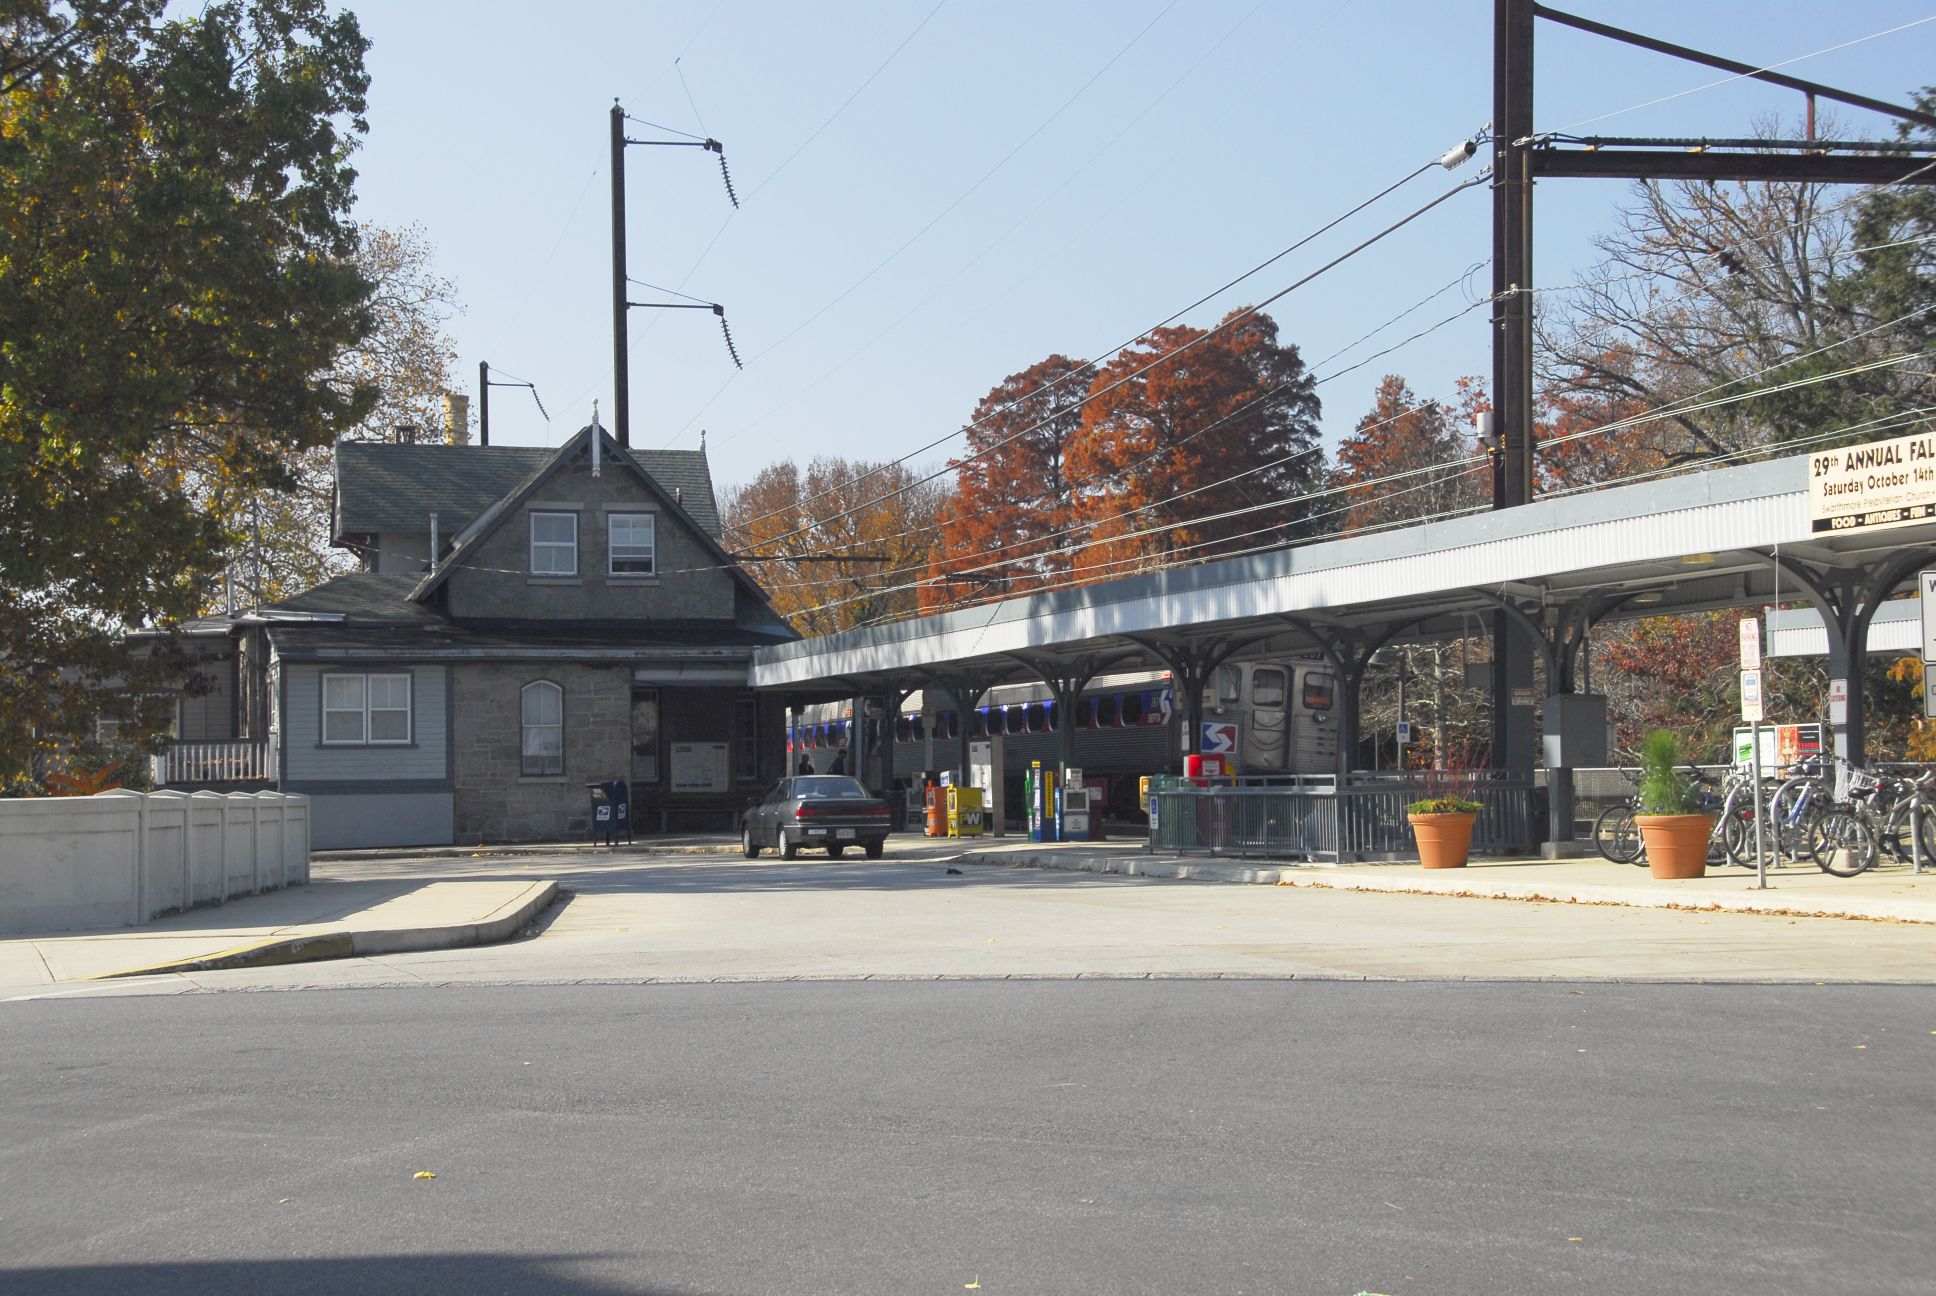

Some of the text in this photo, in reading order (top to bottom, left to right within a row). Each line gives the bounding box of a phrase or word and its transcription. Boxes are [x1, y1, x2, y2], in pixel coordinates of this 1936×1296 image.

[1814, 438, 1936, 477] 29th ANNUAL FAL
[1823, 465, 1934, 497] Saturday October 14th
[1822, 490, 1931, 514] Swarthmore Presbyterian Church
[1831, 516, 1856, 529] FOOD
[1864, 509, 1902, 525] ANTIQUES
[960, 812, 980, 825] PW
